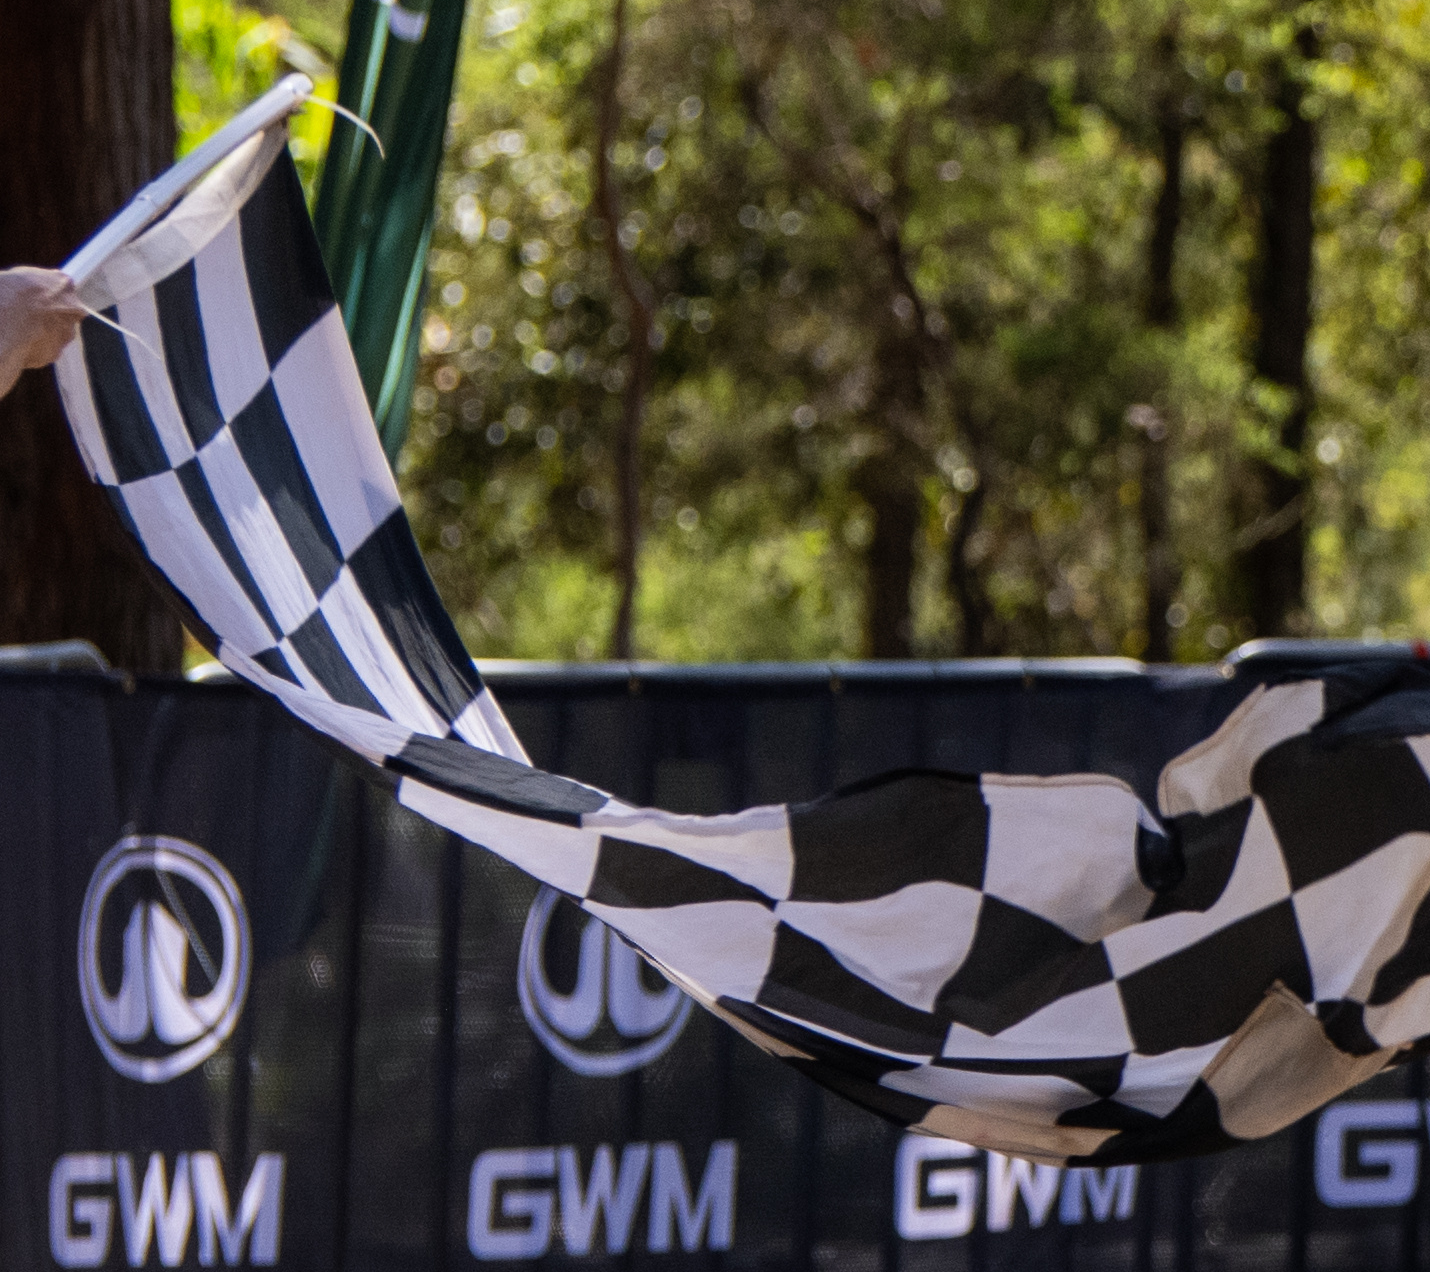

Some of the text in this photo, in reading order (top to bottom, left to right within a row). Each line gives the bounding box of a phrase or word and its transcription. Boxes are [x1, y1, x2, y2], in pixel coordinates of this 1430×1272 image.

[47, 1149, 287, 1269] GWM
[466, 1142, 738, 1262] GWM
[894, 1133, 1140, 1241] GWM
